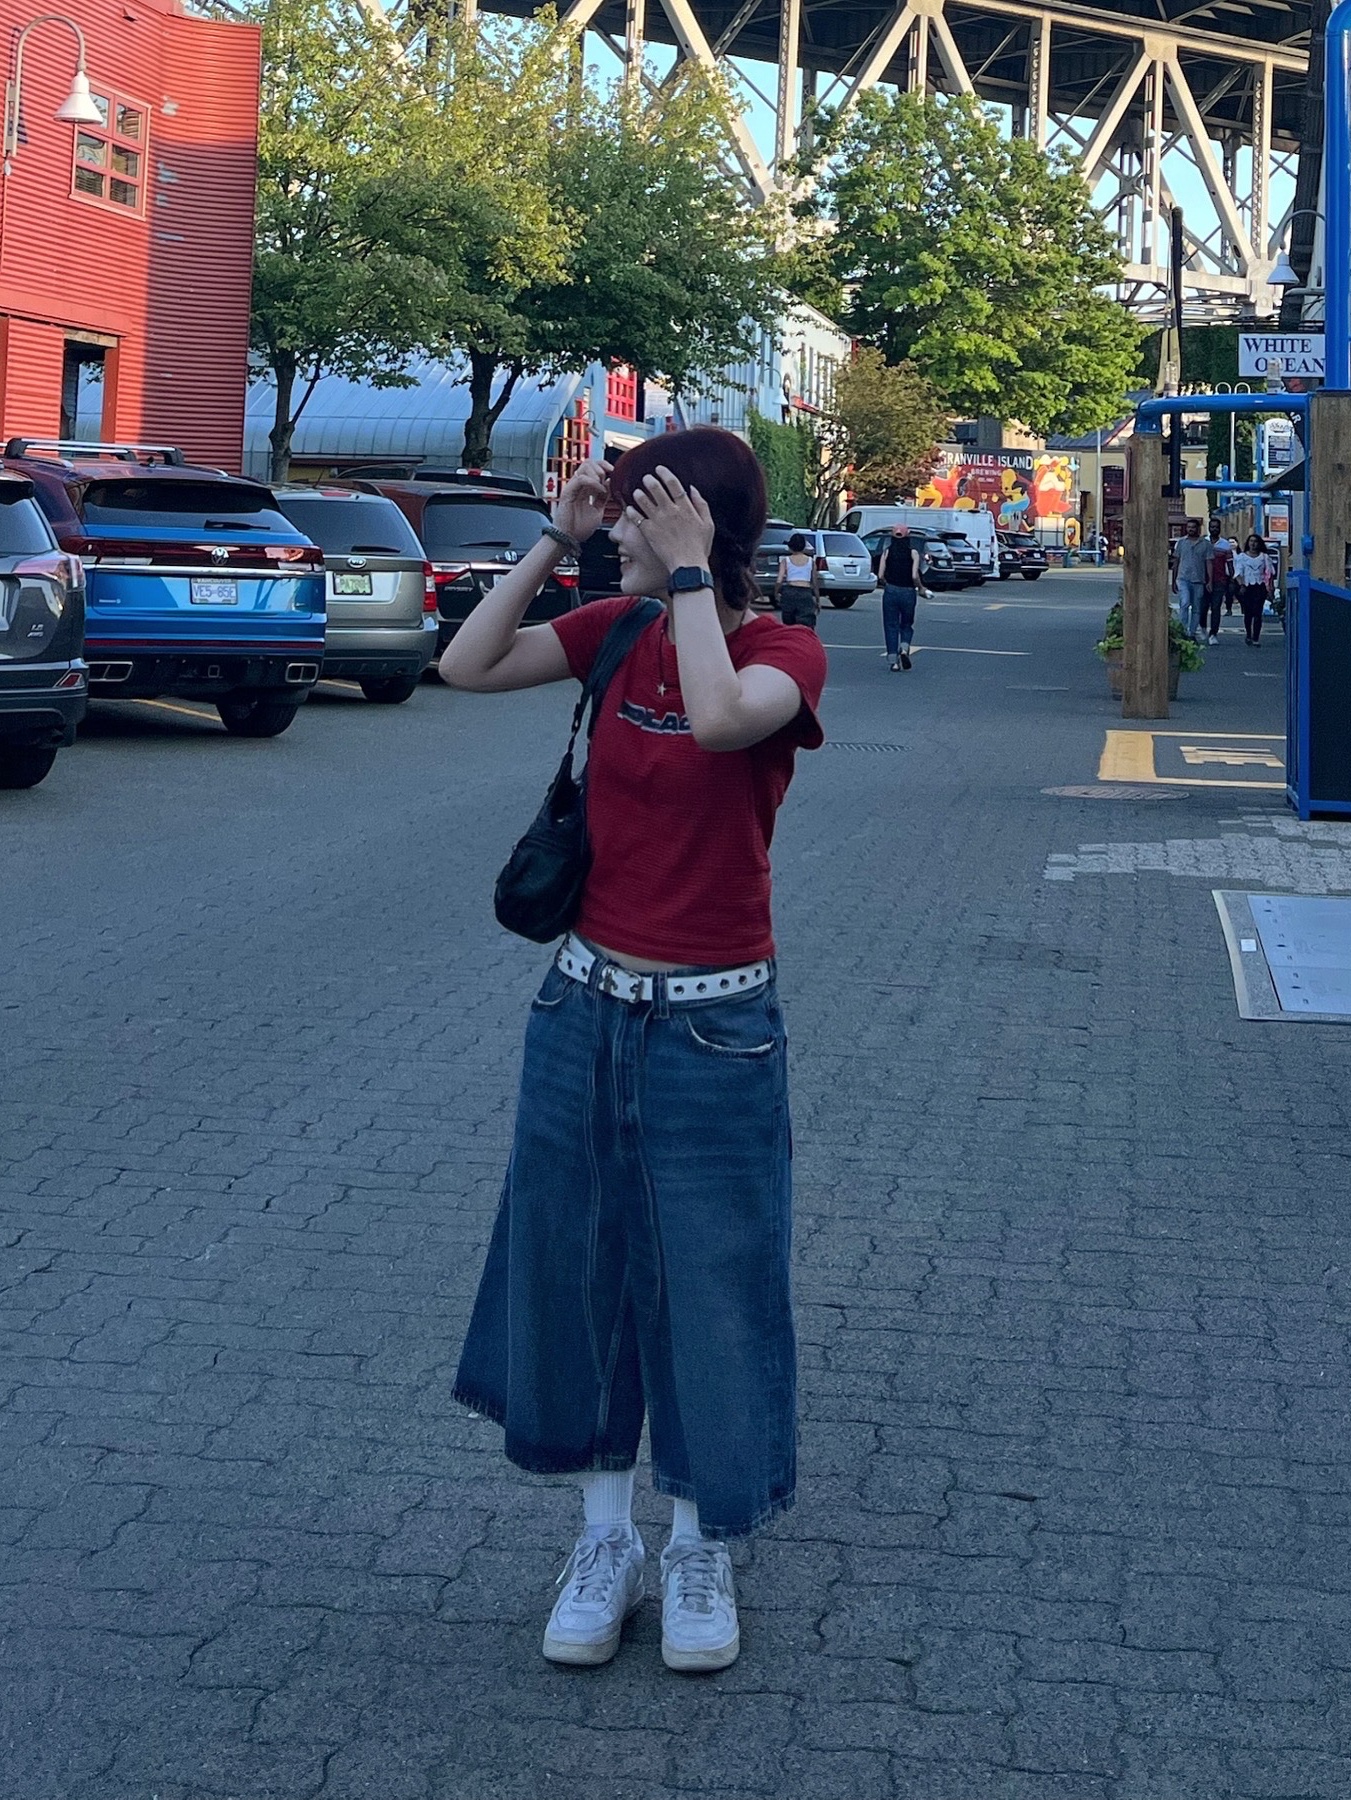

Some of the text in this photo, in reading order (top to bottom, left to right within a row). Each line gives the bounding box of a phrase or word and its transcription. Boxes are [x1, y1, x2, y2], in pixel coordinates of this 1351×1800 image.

[1243, 337, 1312, 354] WHITE
[1254, 357, 1325, 373] OEAN
[938, 451, 1034, 471] GRANVILLE ISLAND
